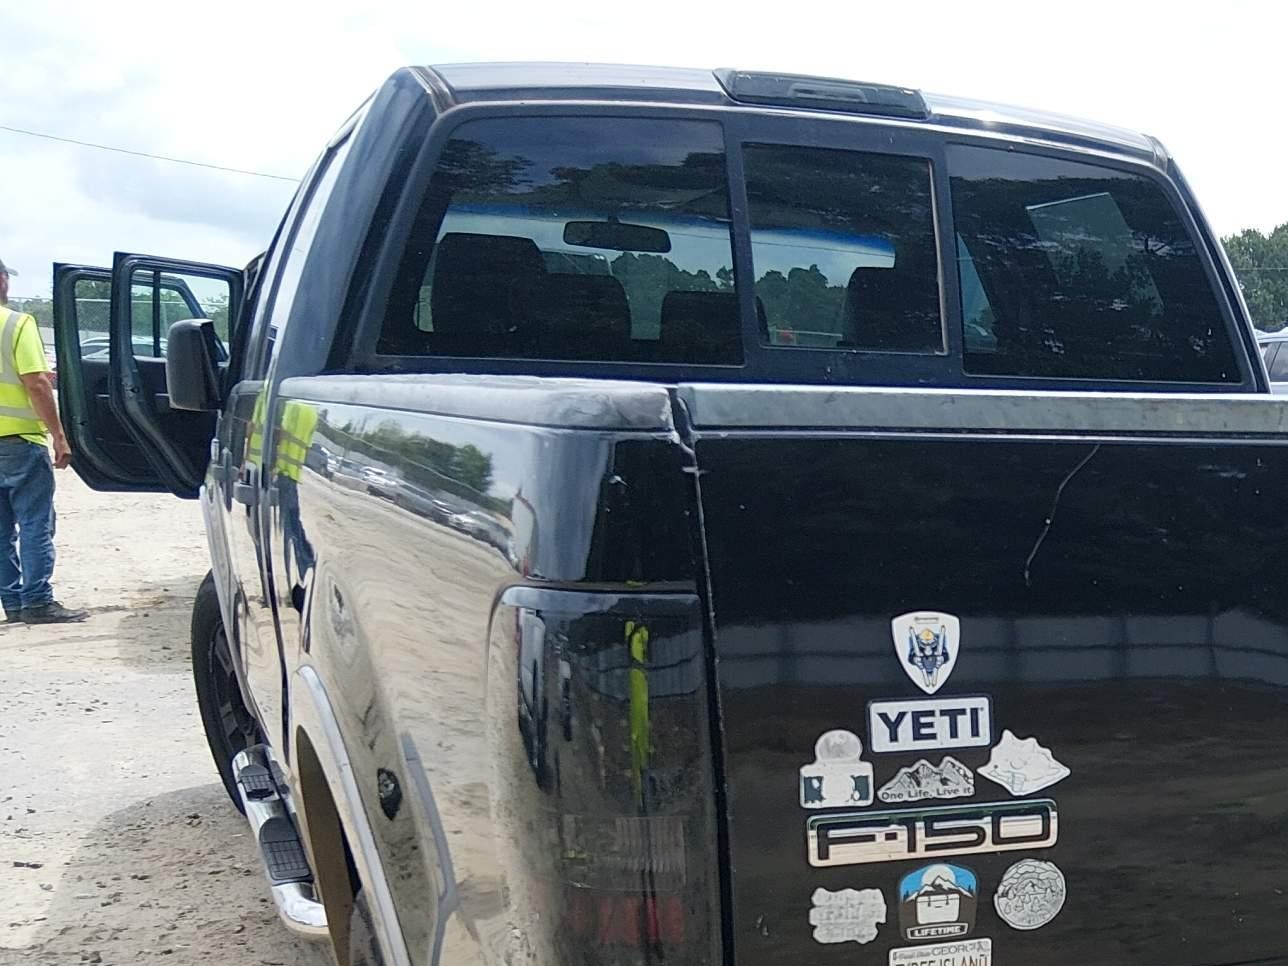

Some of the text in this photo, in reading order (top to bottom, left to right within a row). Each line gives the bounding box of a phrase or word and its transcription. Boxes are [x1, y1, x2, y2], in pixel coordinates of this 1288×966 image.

[877, 707, 981, 743] YETI
[936, 787, 960, 797] Live
[817, 804, 1051, 861] F-150
[914, 925, 961, 937] LIFETIME
